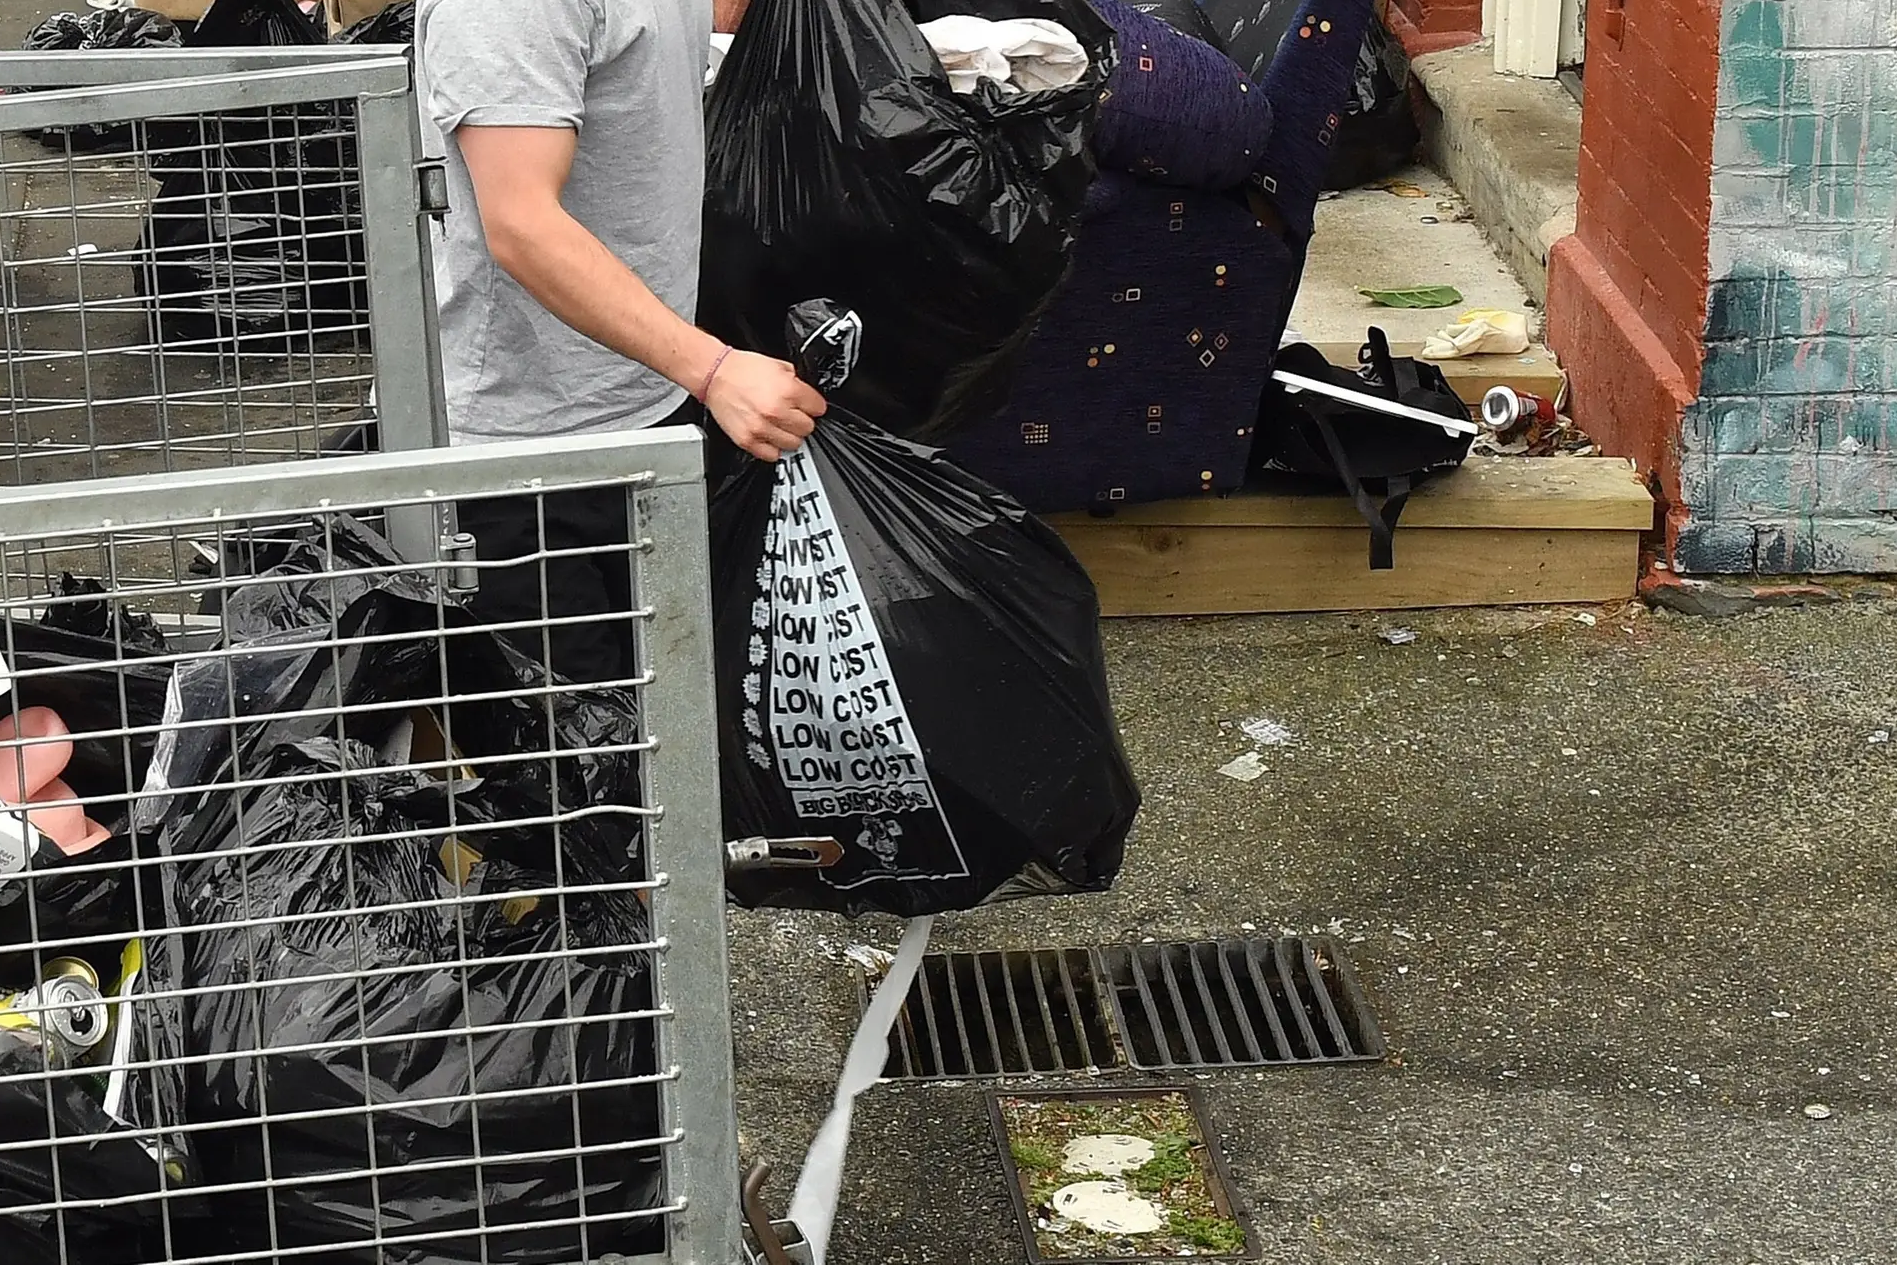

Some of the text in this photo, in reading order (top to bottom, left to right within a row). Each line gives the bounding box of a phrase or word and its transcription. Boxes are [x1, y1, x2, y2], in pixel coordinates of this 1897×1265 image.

[773, 646, 820, 683] LOW
[773, 679, 893, 723] LOW COST
[775, 716, 905, 753] LOW COST
[782, 753, 917, 783] LOW COST
[799, 797, 836, 816] BIG
